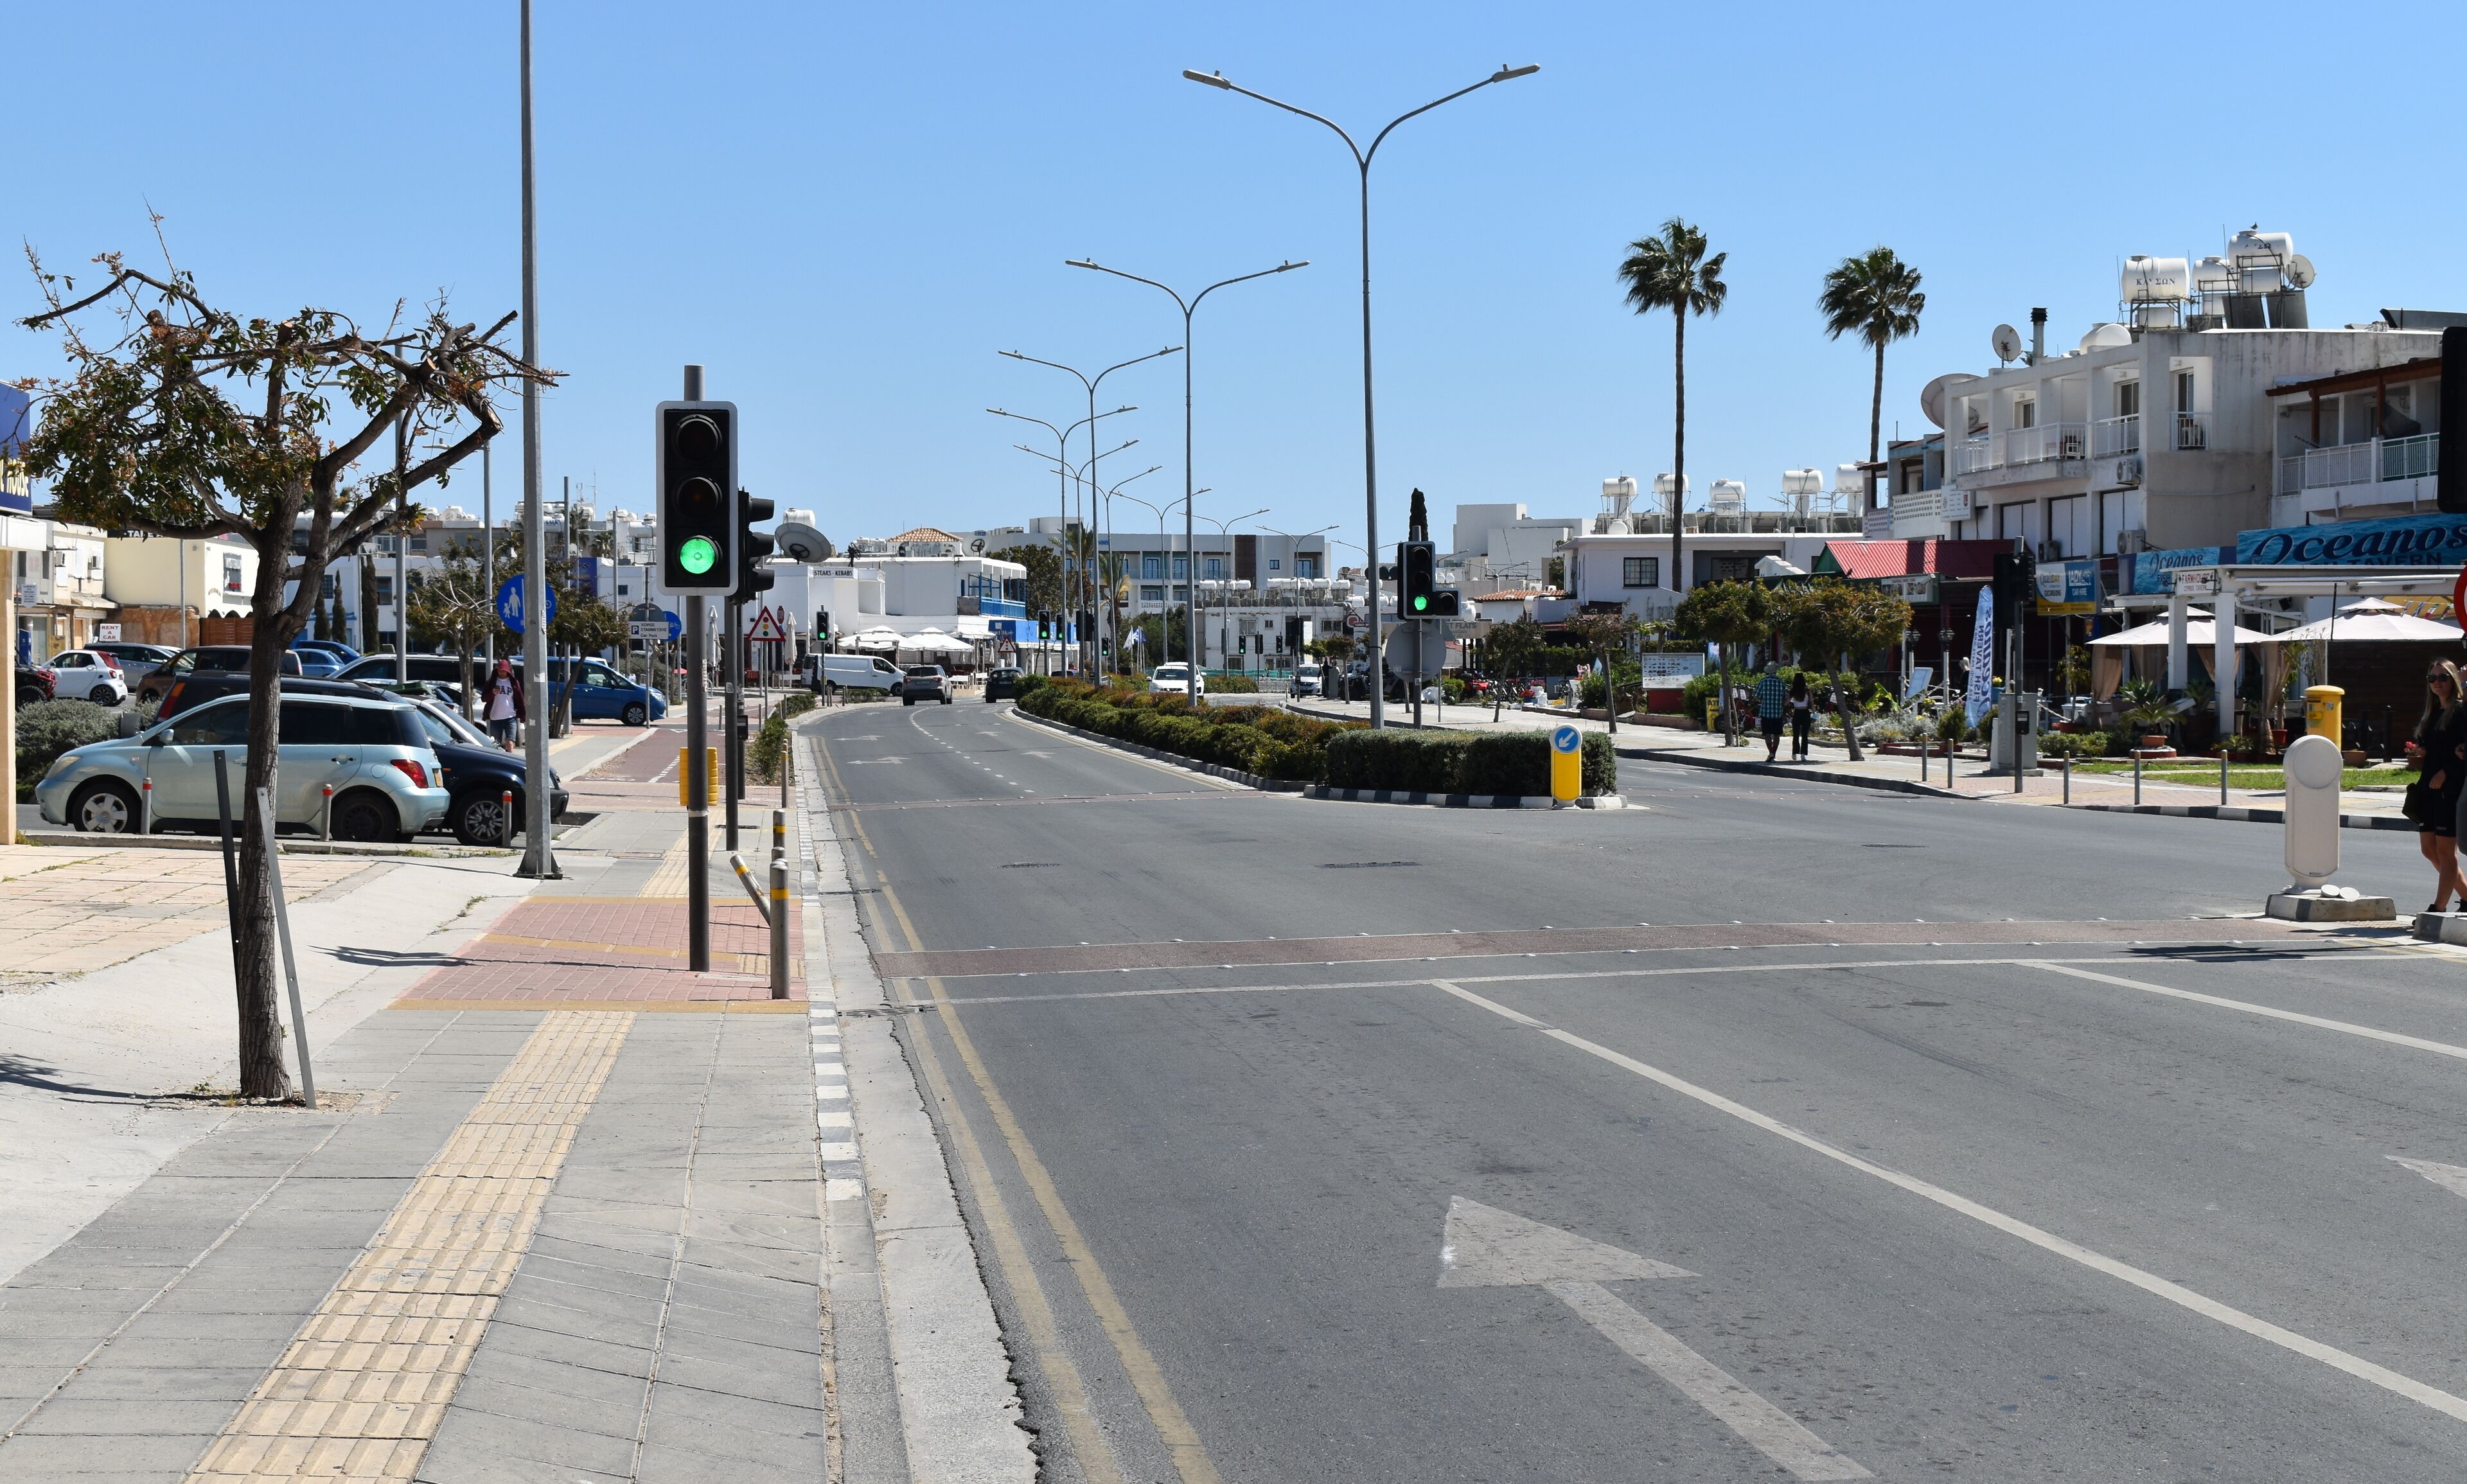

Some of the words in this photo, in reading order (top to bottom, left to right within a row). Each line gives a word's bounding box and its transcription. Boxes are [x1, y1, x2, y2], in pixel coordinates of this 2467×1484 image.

[2136, 278, 2176, 286] ΚΑΣΩΝ
[2250, 523, 2467, 565] Oceanos
[2149, 552, 2204, 576] Oceanos
[2068, 569, 2082, 583] LADY
[497, 685, 513, 696] AP
